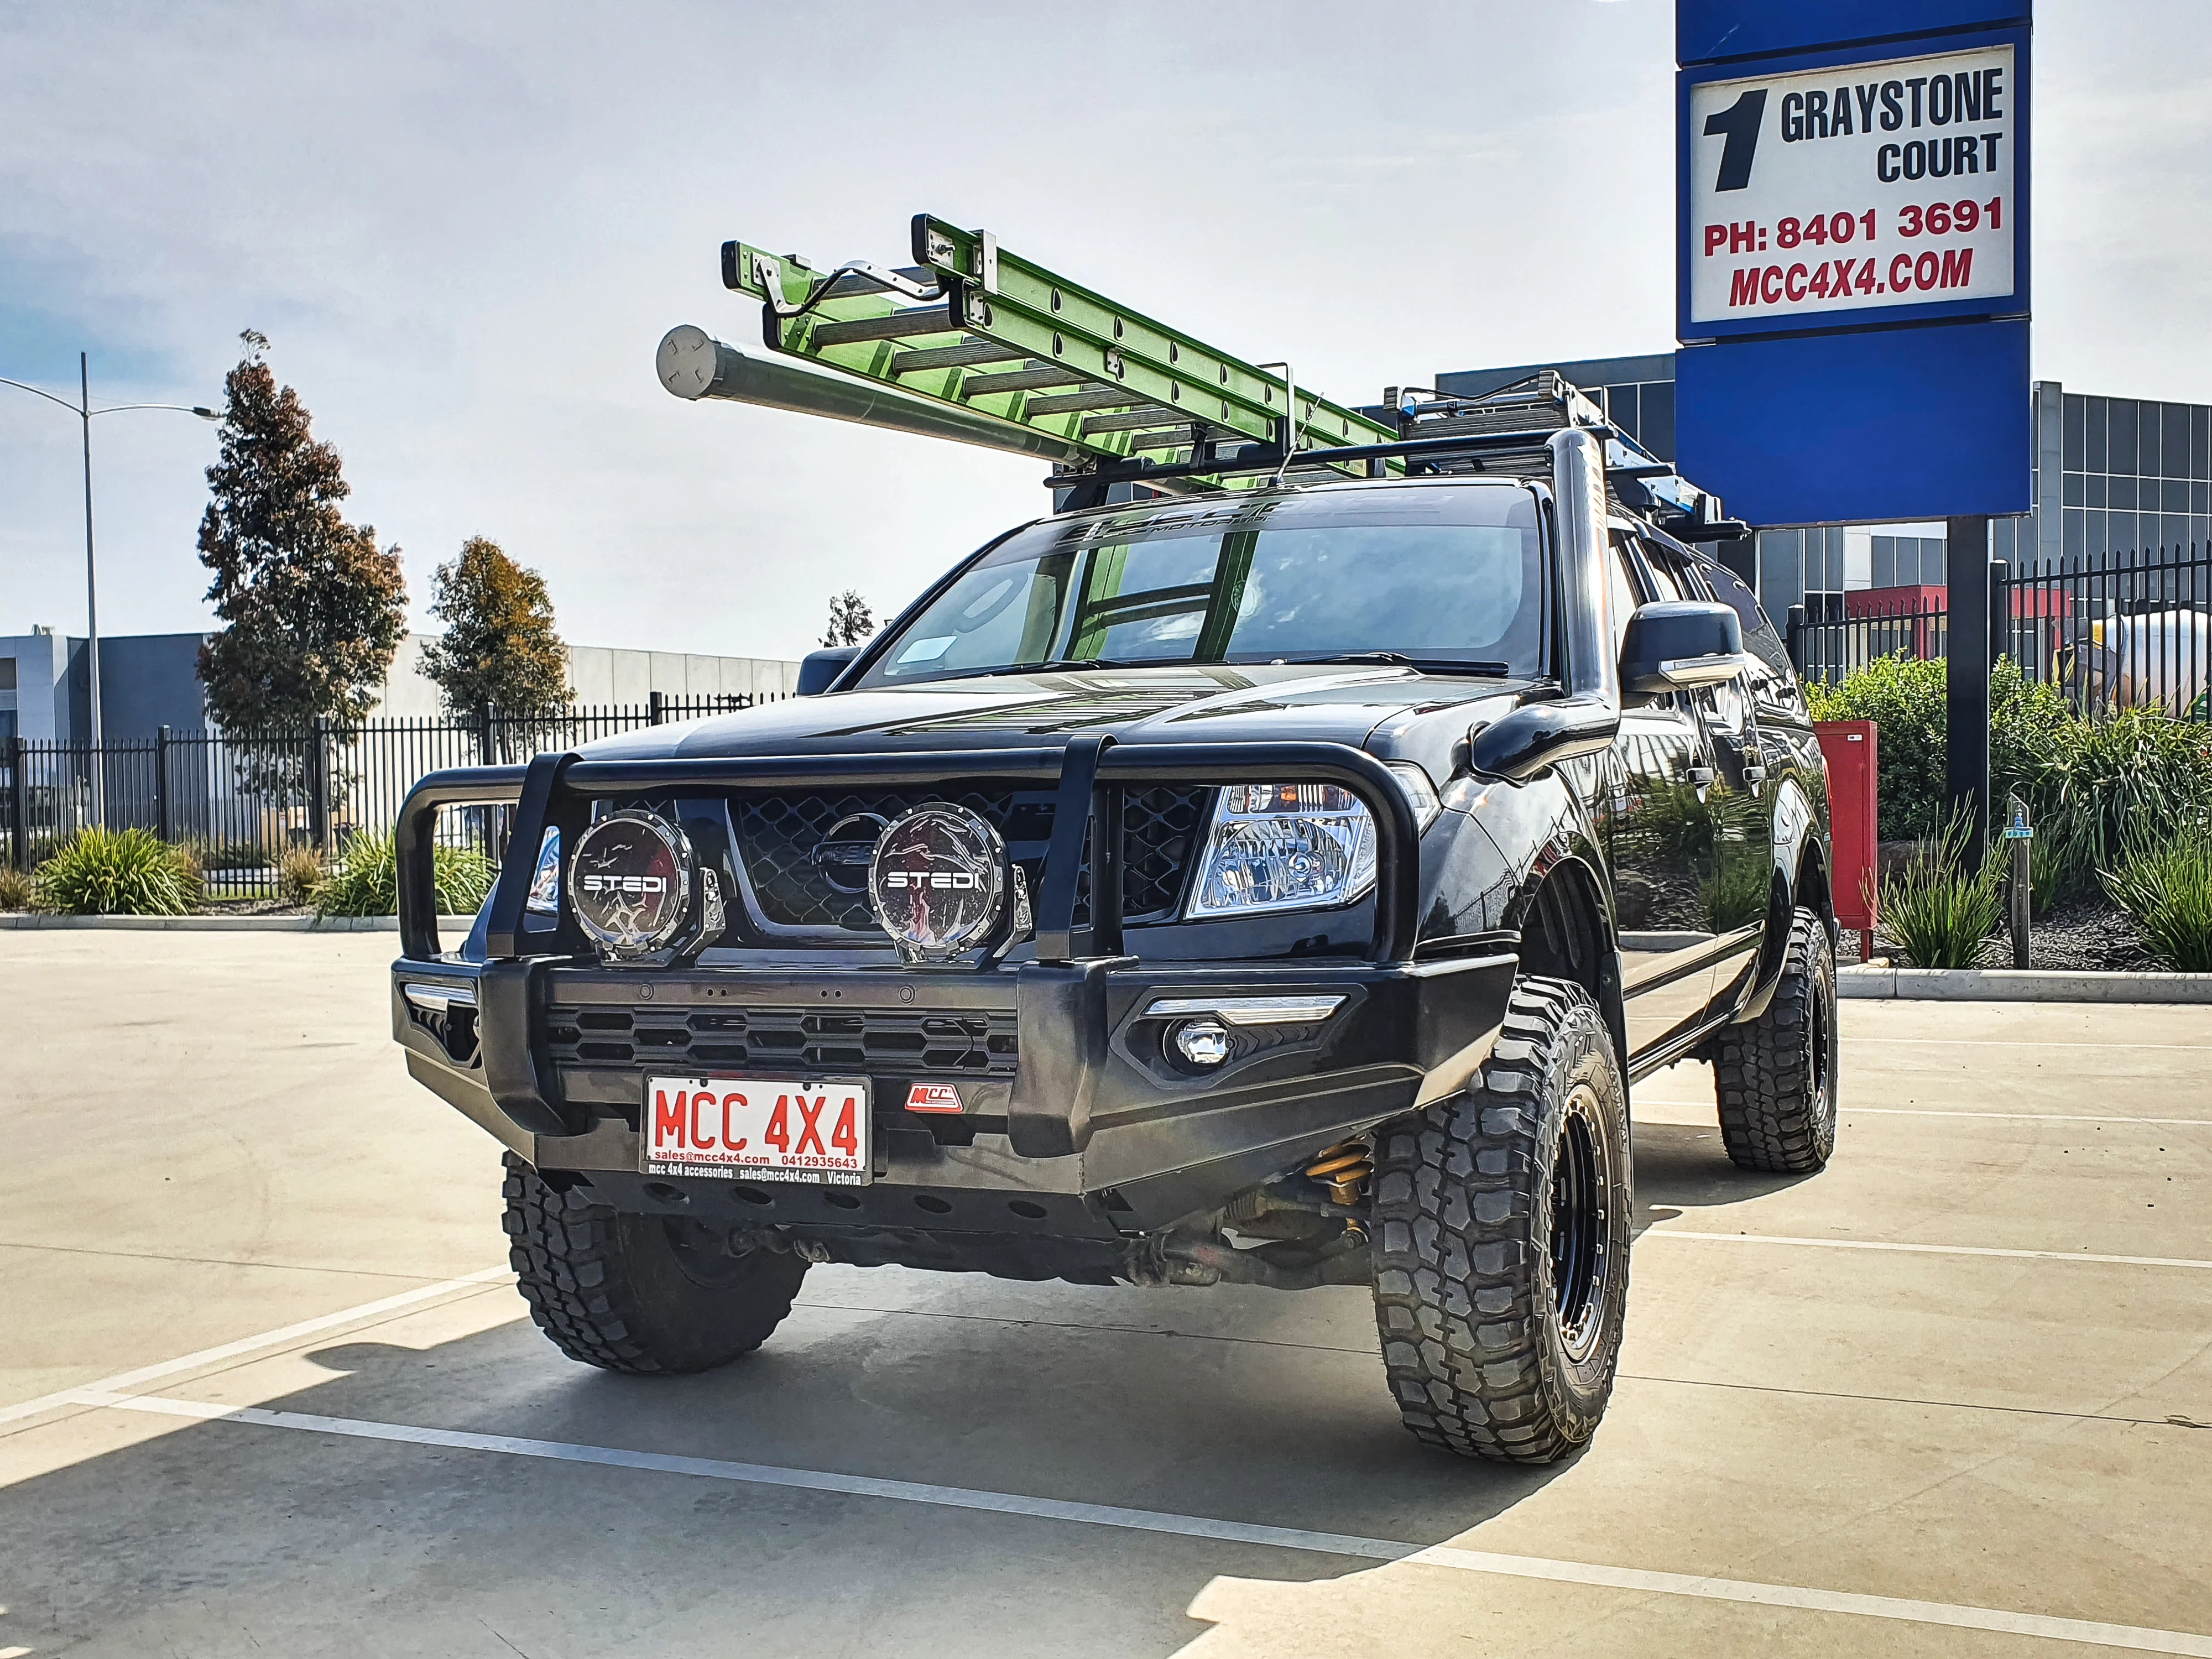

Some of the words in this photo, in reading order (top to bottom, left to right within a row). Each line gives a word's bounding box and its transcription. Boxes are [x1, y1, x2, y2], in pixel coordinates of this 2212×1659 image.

[1703, 88, 1768, 192] 1
[1781, 67, 2002, 142] GRAYSTONE
[1877, 132, 2002, 182] COURT
[1704, 220, 1767, 256] PH:
[1776, 208, 1876, 249] 8401
[1898, 196, 2001, 237] 3691
[1729, 248, 1974, 306] MCC4X4.COM
[583, 875, 667, 893] STEDI
[887, 872, 979, 889] STEDI
[910, 1088, 954, 1104] MCC
[655, 1090, 747, 1151] MCC
[764, 1095, 858, 1156] 4X4
[649, 1164, 666, 1175] mcc
[667, 1162, 682, 1176] 4x4
[684, 1165, 733, 1178] accessories
[739, 1167, 820, 1183] sales@mcc4x4.com
[827, 1171, 862, 1186] Victoria
[655, 1150, 770, 1165] sales@mcc4x4.com
[781, 1155, 858, 1168] 0412935643
